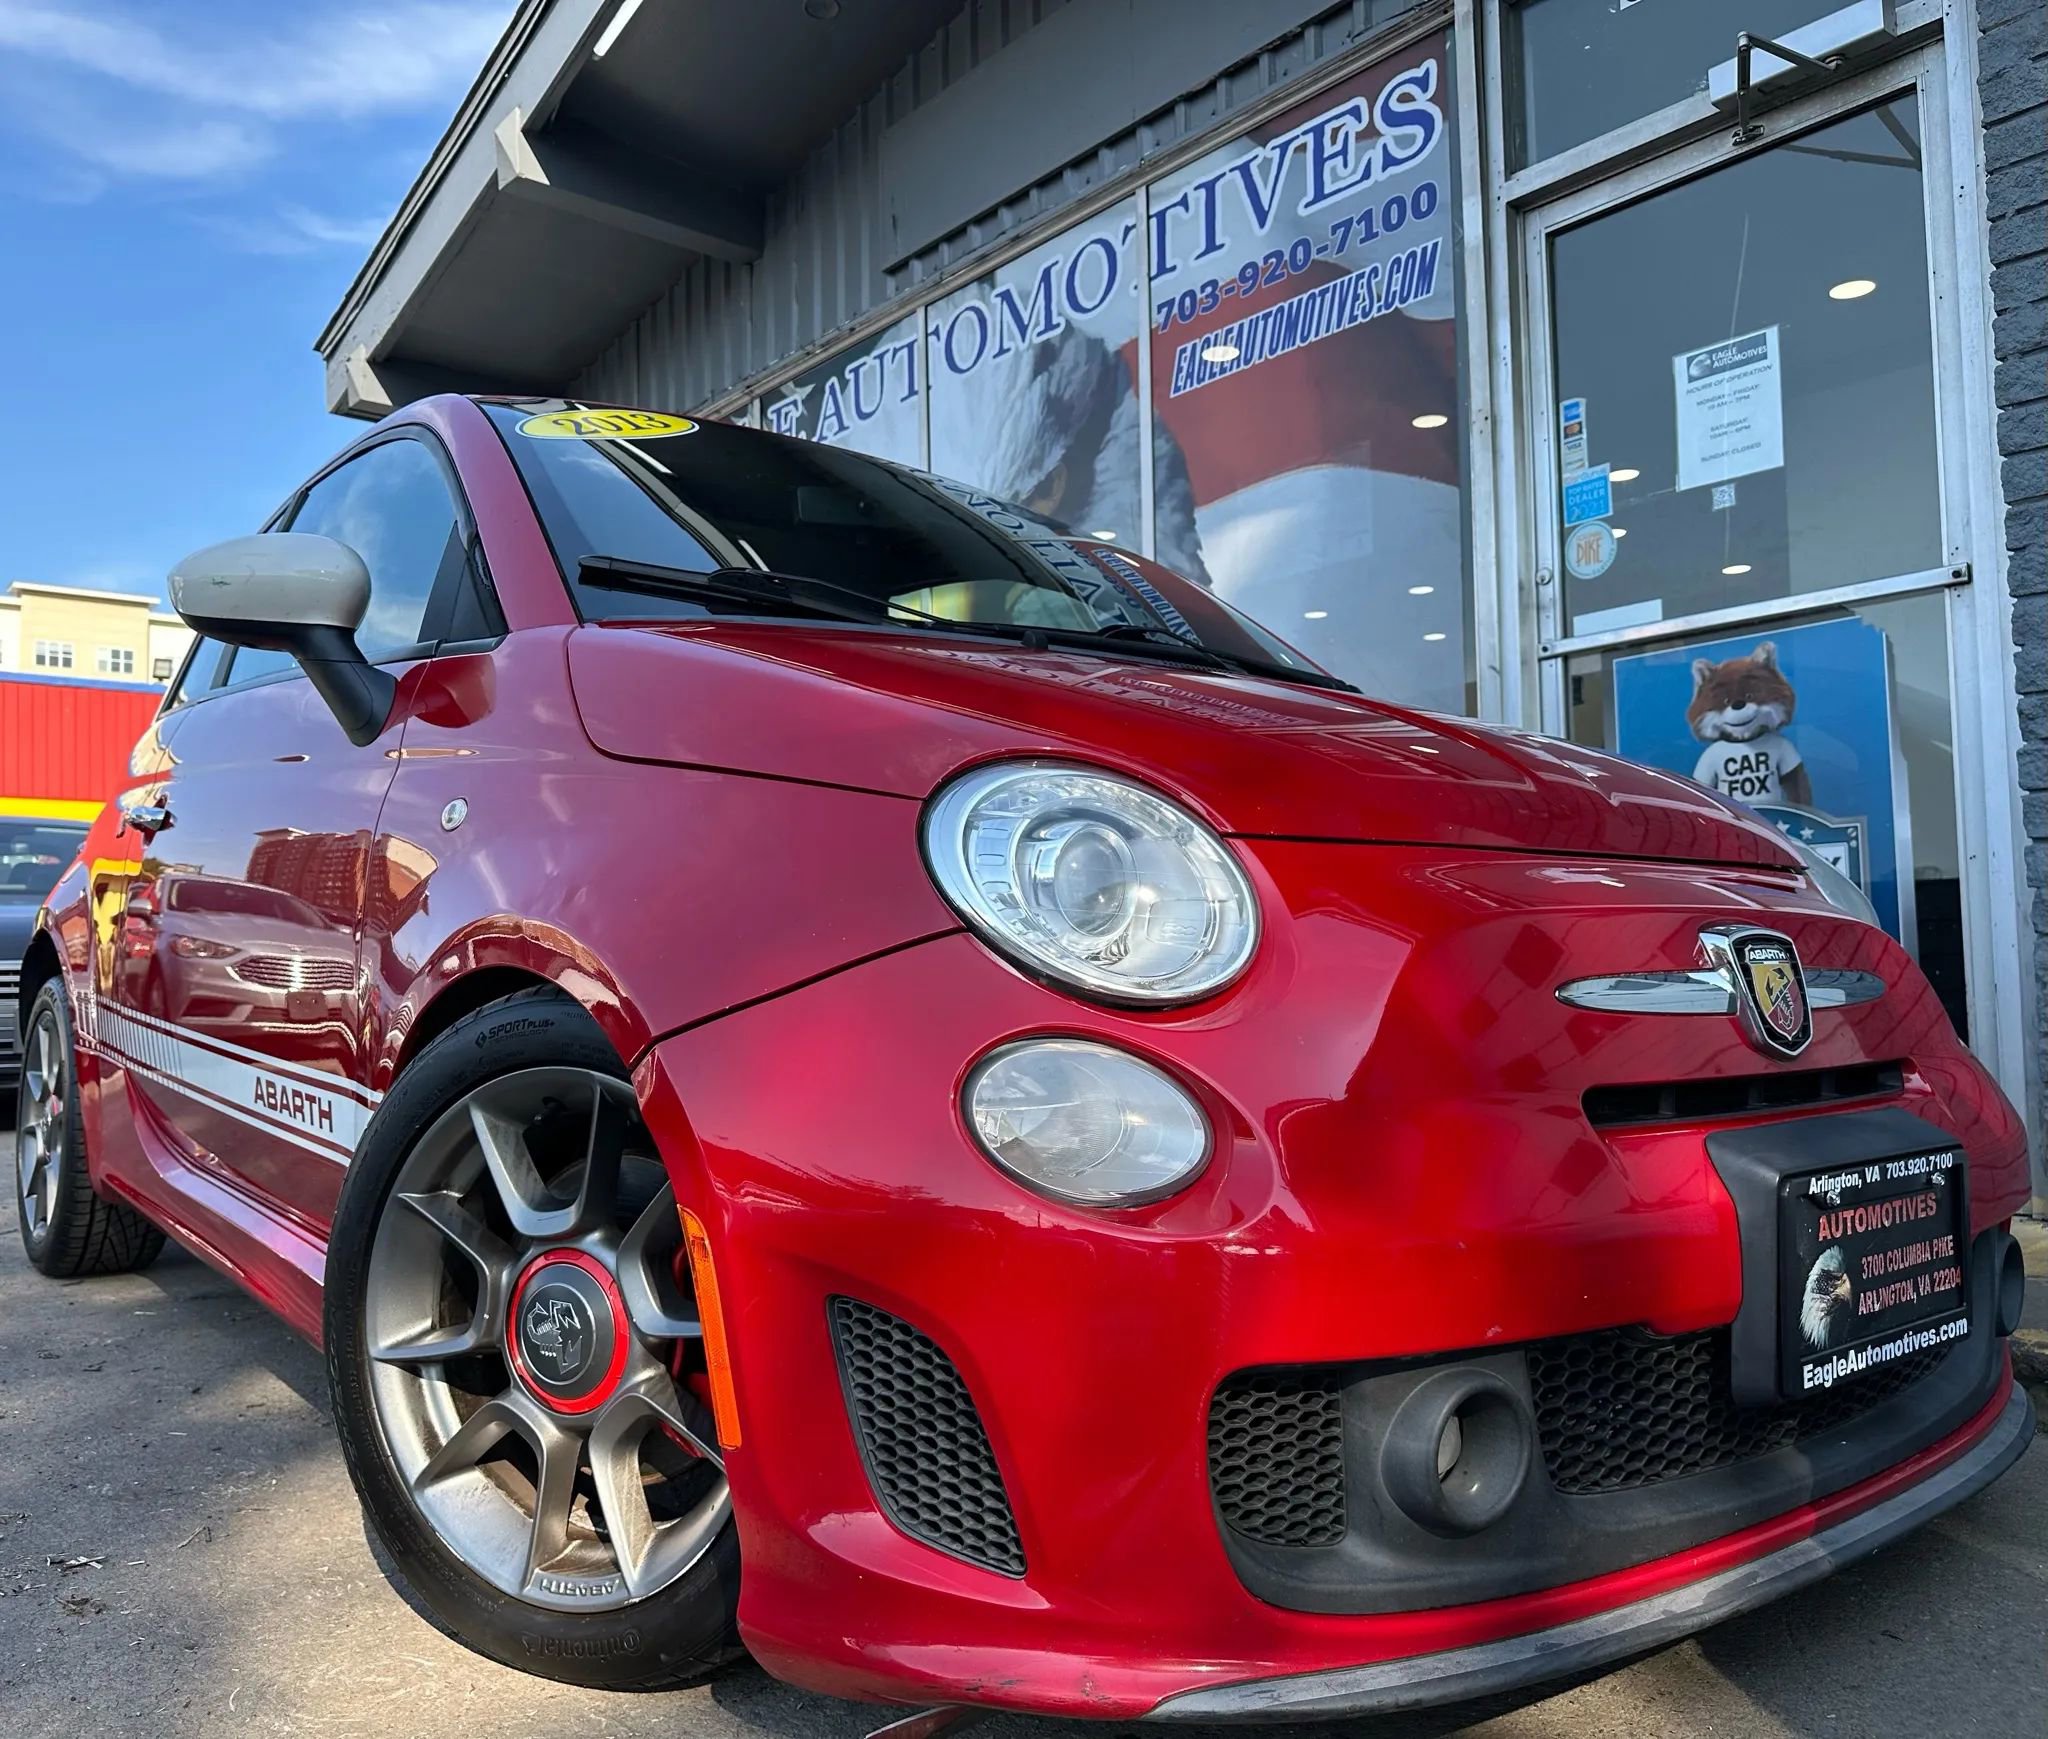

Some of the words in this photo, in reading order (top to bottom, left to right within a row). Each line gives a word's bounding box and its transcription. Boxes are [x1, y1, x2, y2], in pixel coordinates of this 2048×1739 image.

[816, 62, 1439, 442] AUTOMOTIVES
[1156, 181, 1438, 333] 703-920-7100
[1171, 238, 1441, 397] EAGLEAUTOMOTIVES.COM
[1712, 347, 1737, 361] EAGLE
[1712, 345, 1767, 368] AUTOMOTIVES
[1713, 378, 1725, 387] OF
[1726, 364, 1773, 383] OPERATION
[552, 413, 673, 436] 2013
[1569, 488, 1606, 505] DEALER
[1724, 751, 1770, 777] CAR
[1728, 774, 1771, 797] FOX
[1749, 948, 1786, 960] ABARTH
[254, 1076, 334, 1133] ABARTH
[1808, 1172, 1862, 1195] Arlington,
[1865, 1165, 1881, 1183] VA
[1886, 1152, 1953, 1180] 703.920.7100
[1818, 1191, 1937, 1242] AUTOMOTIVES
[1861, 1253, 1885, 1280] 3700
[1886, 1239, 1931, 1273] COLUMBIA
[1932, 1234, 1955, 1260] PIKE
[1858, 1282, 1917, 1316] ARLINGTON,
[1918, 1274, 1931, 1297] VA
[1933, 1266, 1962, 1293] 22204
[1803, 1317, 1969, 1389] EagleAutomotives.com
